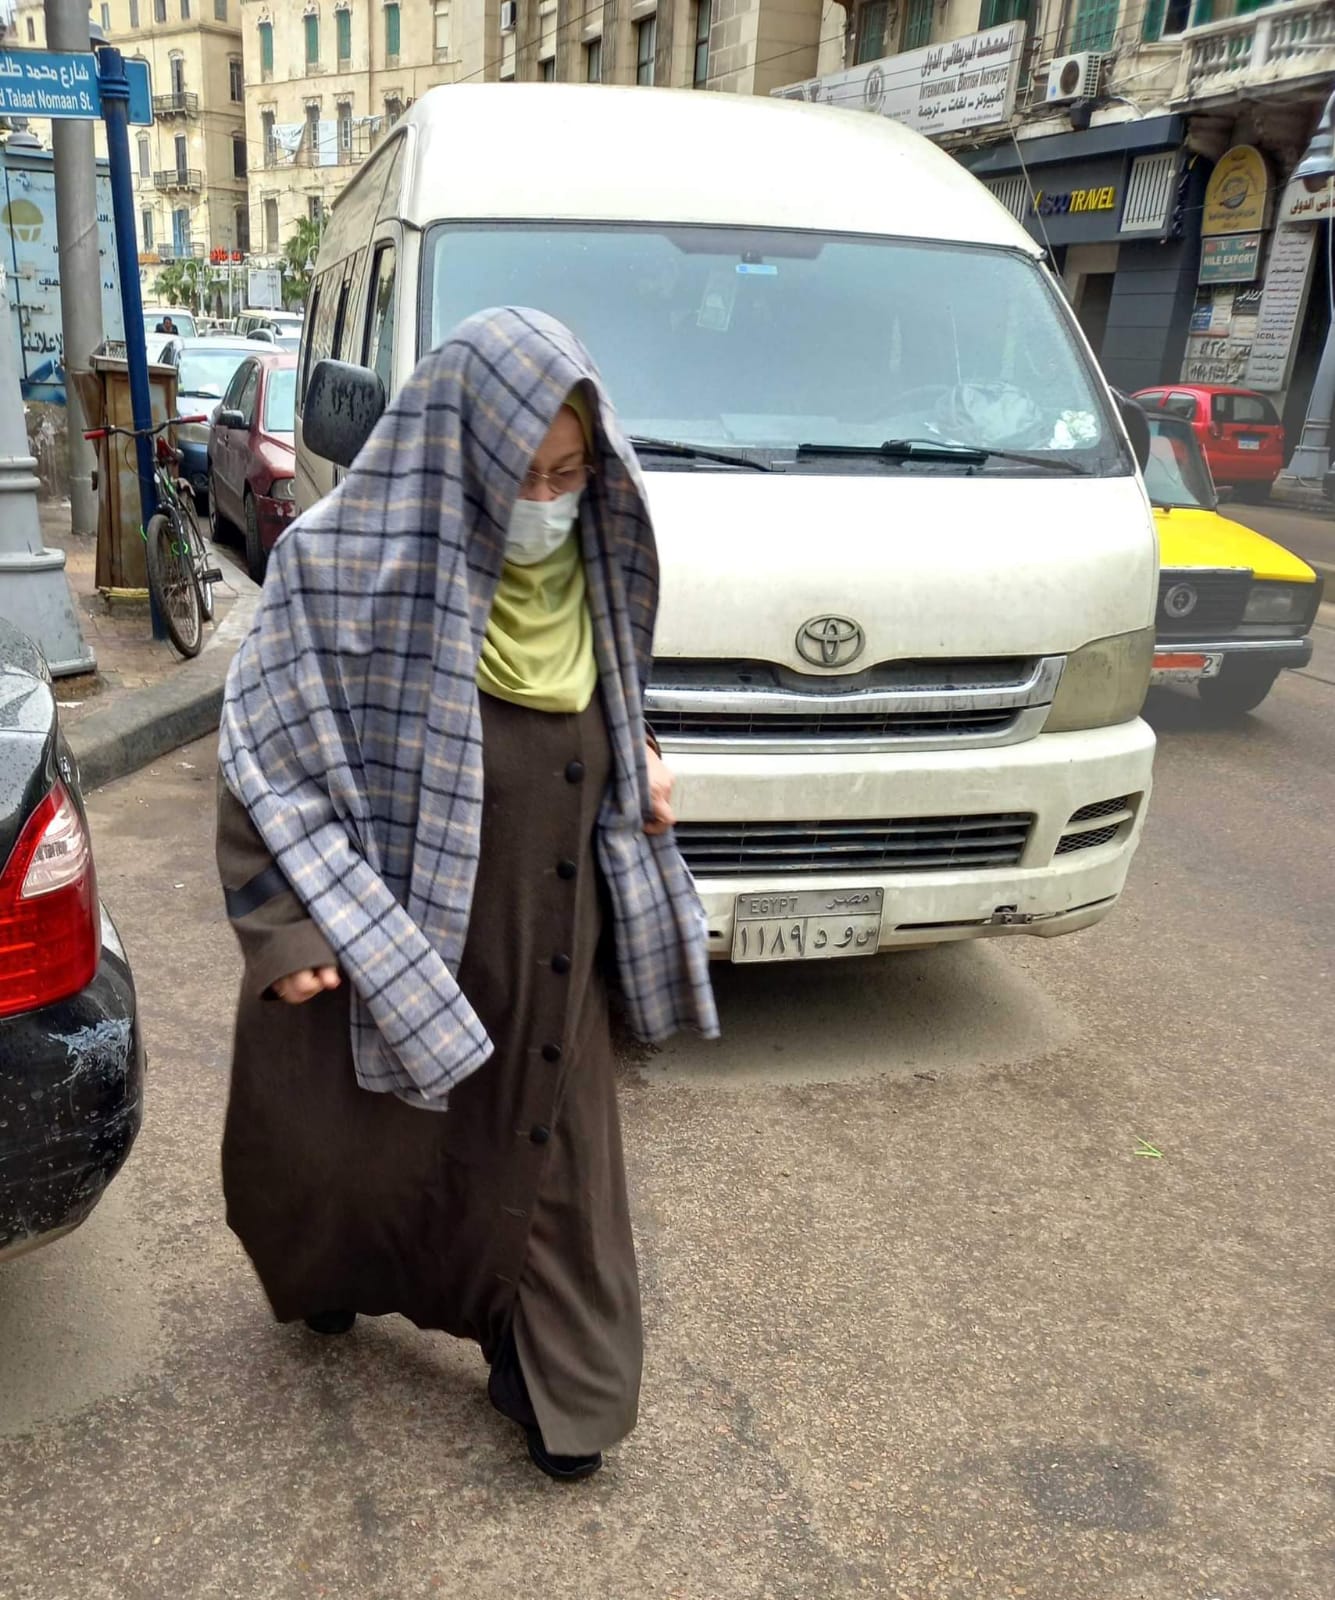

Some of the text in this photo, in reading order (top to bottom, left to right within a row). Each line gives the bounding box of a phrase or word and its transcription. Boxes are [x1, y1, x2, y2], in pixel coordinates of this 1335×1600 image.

[0, 56, 89, 89] شارع محمد طلع
[6, 87, 37, 107] Talaat
[37, 89, 78, 110] Nomaan
[80, 91, 93, 111] St.
[1069, 187, 1115, 213] TRAVEL
[1204, 252, 1255, 265] NILE EXPORT
[1256, 332, 1276, 341] ICDL
[751, 897, 798, 914] EGYPT
[826, 893, 870, 910] مصر
[741, 925, 802, 956] ١١٨٩
